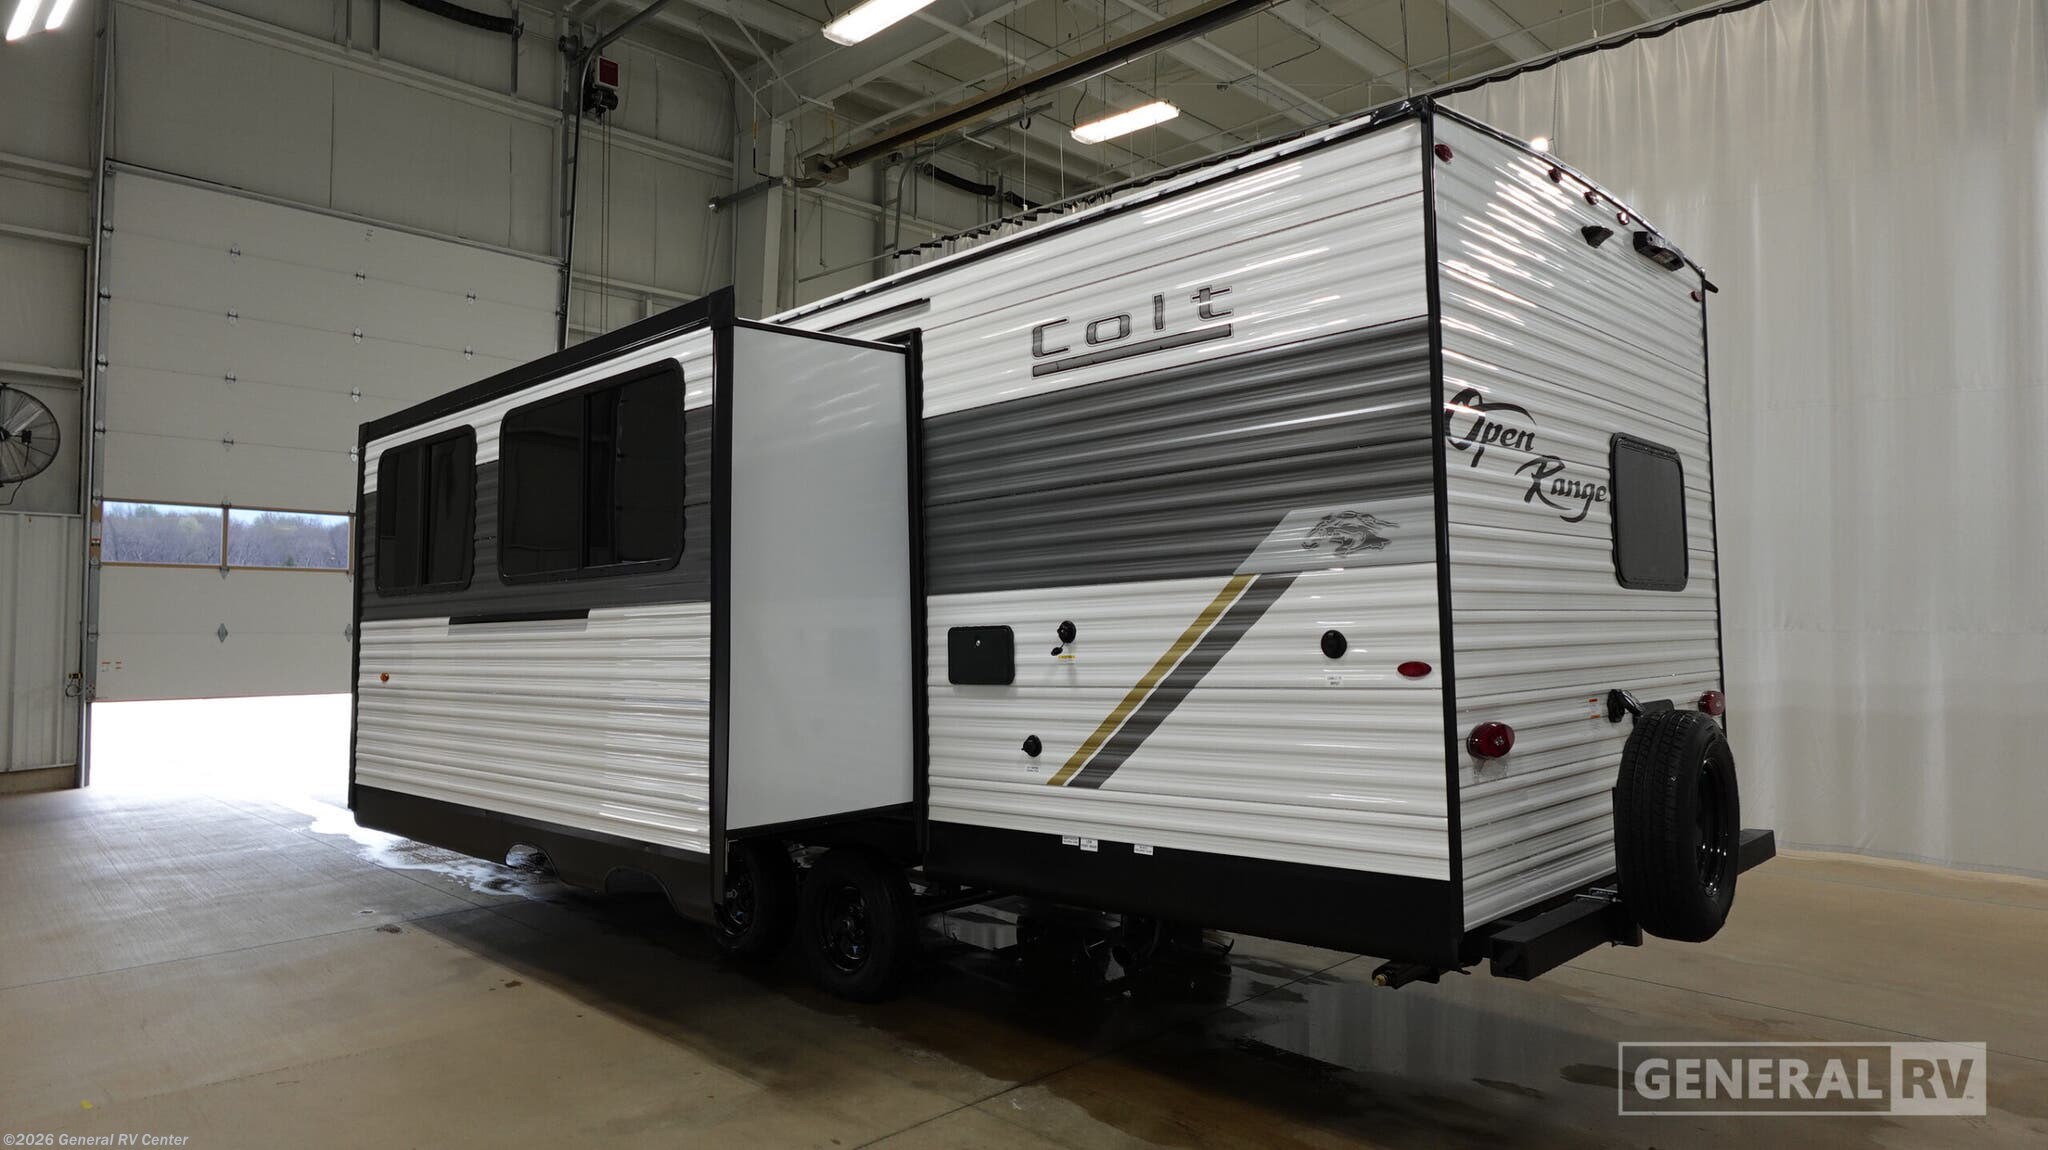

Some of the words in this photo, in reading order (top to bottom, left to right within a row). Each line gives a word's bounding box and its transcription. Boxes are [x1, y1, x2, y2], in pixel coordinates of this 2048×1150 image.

[1031, 285, 1234, 359] Colt
[1445, 387, 1537, 468] Open
[1514, 454, 1608, 523] Range
